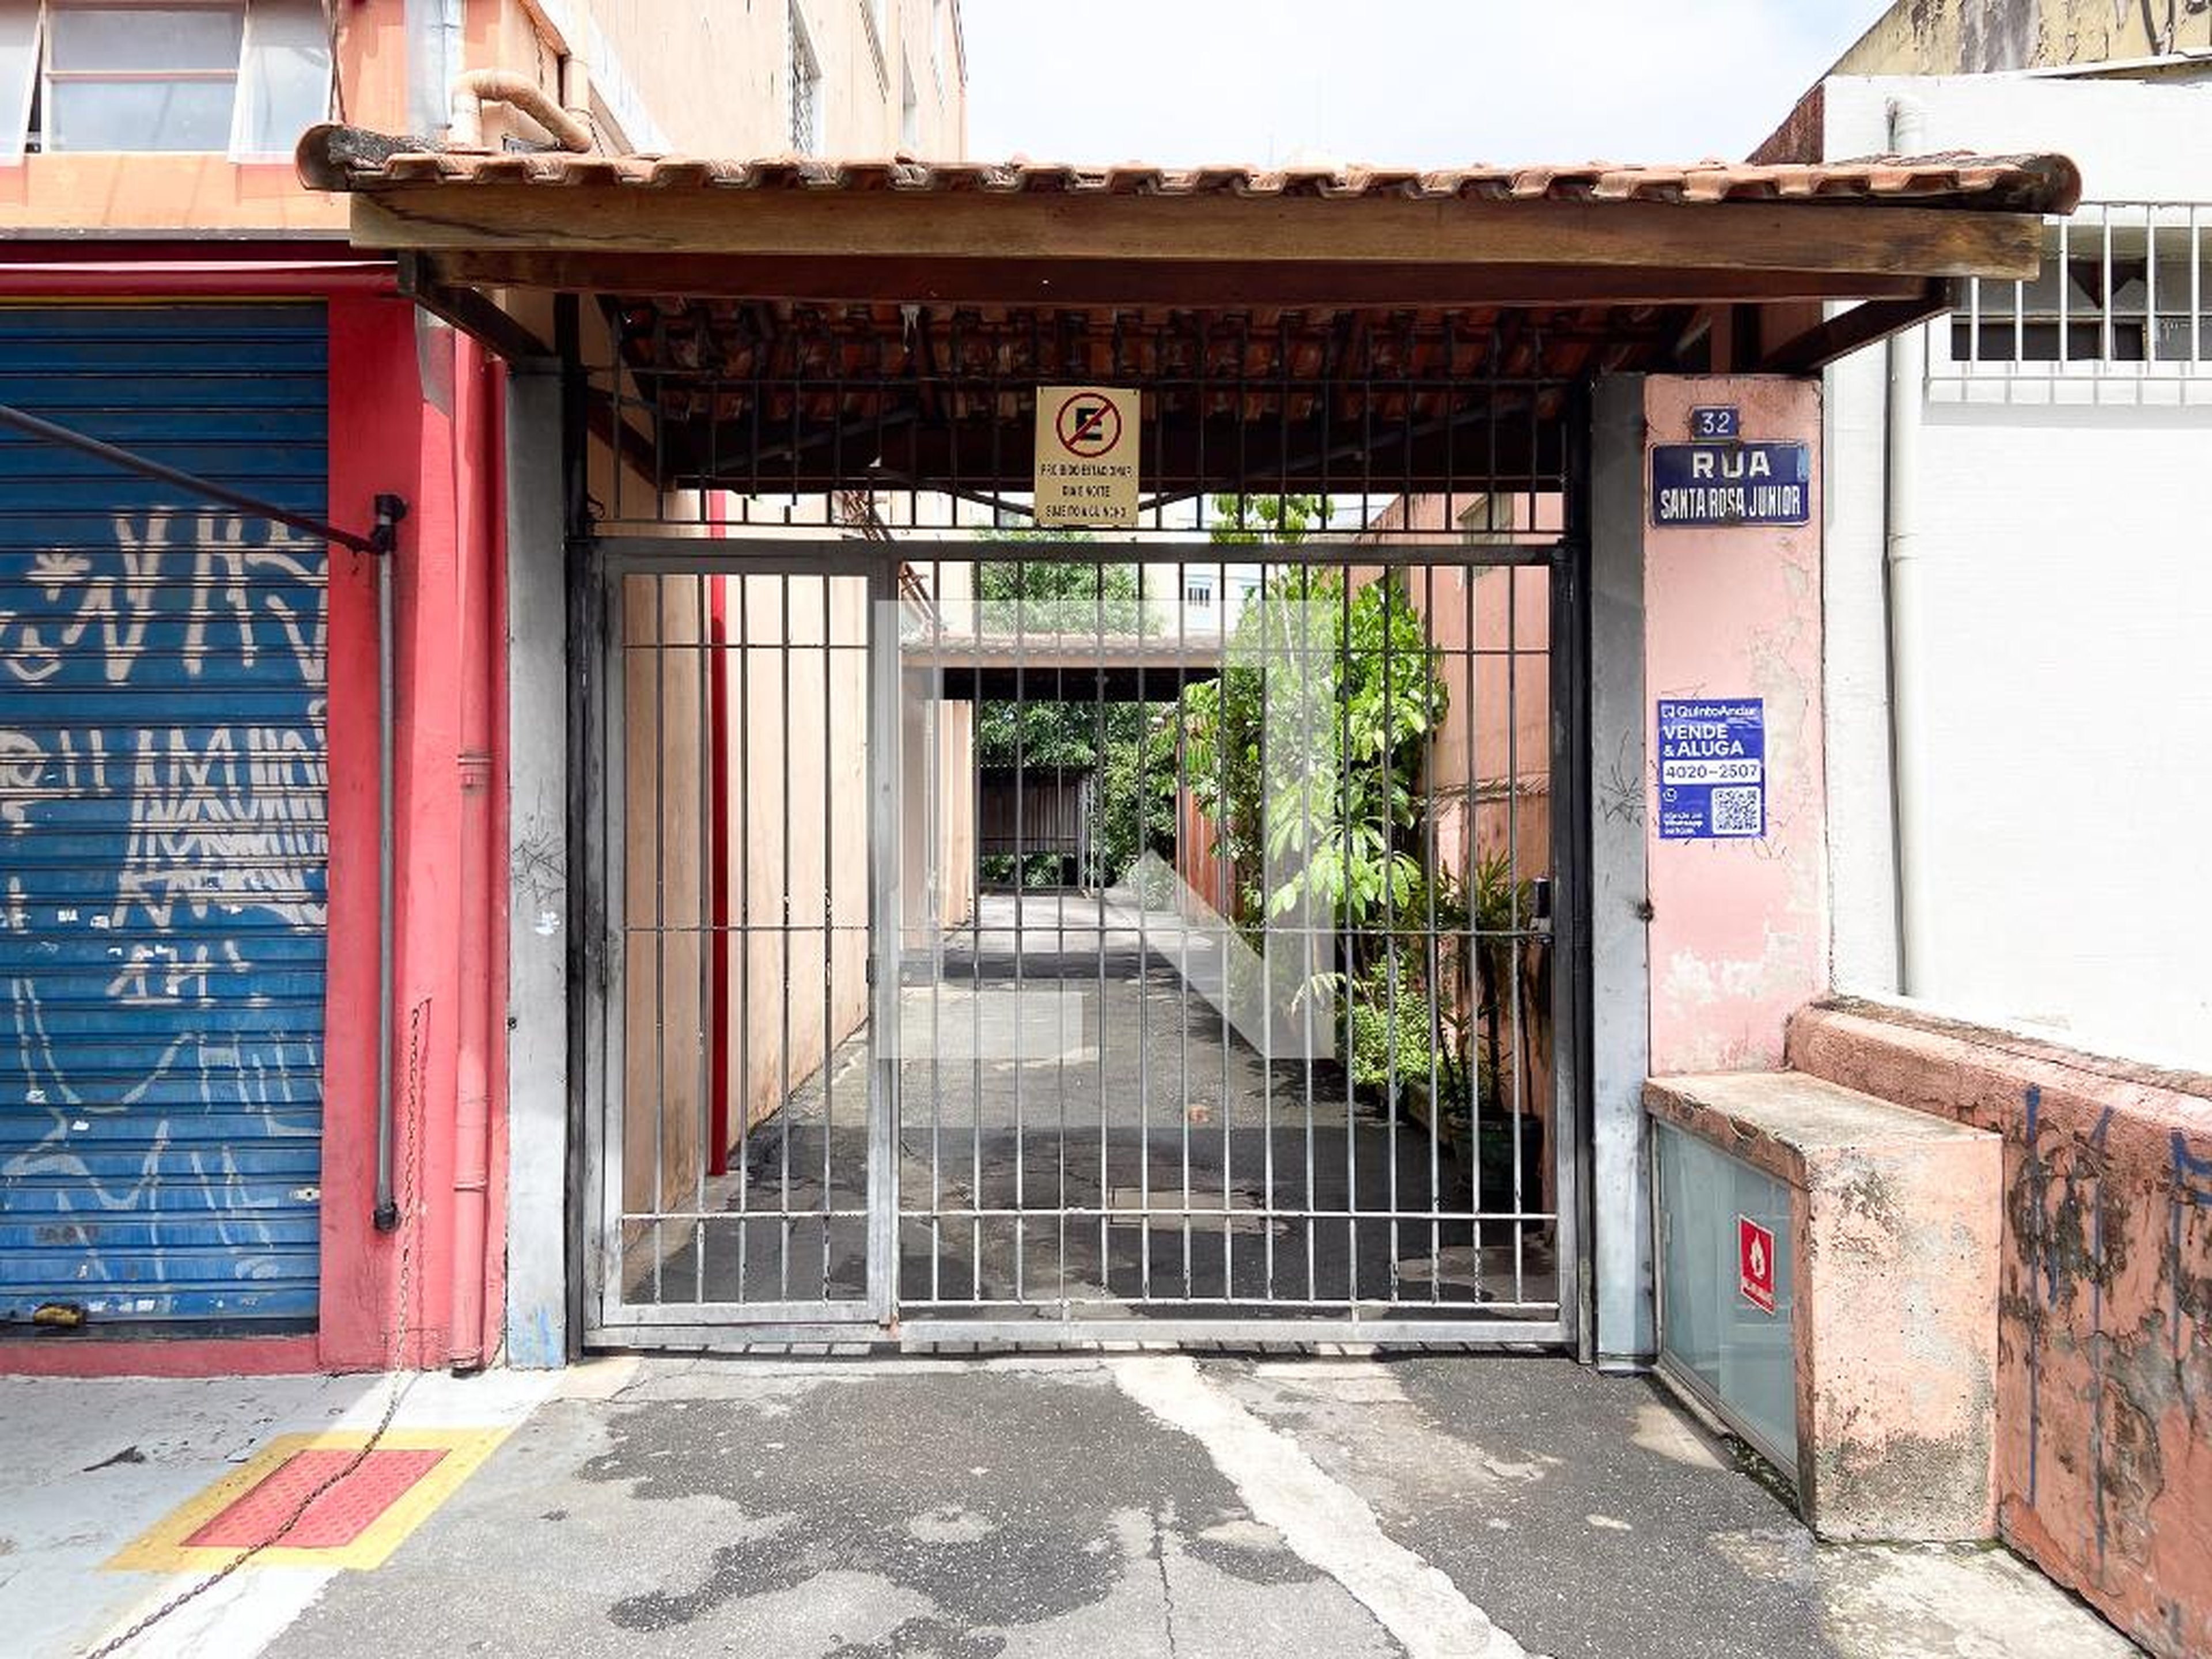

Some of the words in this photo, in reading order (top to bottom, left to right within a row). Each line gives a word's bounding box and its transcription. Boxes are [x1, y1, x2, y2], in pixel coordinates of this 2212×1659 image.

[1701, 411, 1730, 434] 32
[1040, 463, 1080, 476] PROBDO
[1081, 463, 1133, 478] ESTACONAR
[1692, 450, 1771, 478] RUA
[1062, 485, 1076, 497] DA
[1660, 487, 1706, 519] SANTA
[1709, 487, 1745, 518] ROSA
[1749, 485, 1801, 517] JUNIOR
[1089, 505, 1126, 518] GUNCHO
[1662, 724, 1729, 740] VENDE
[1664, 745, 1675, 757] &
[1676, 740, 1744, 757] ALUGA
[1665, 764, 1758, 779] 4020-2507
